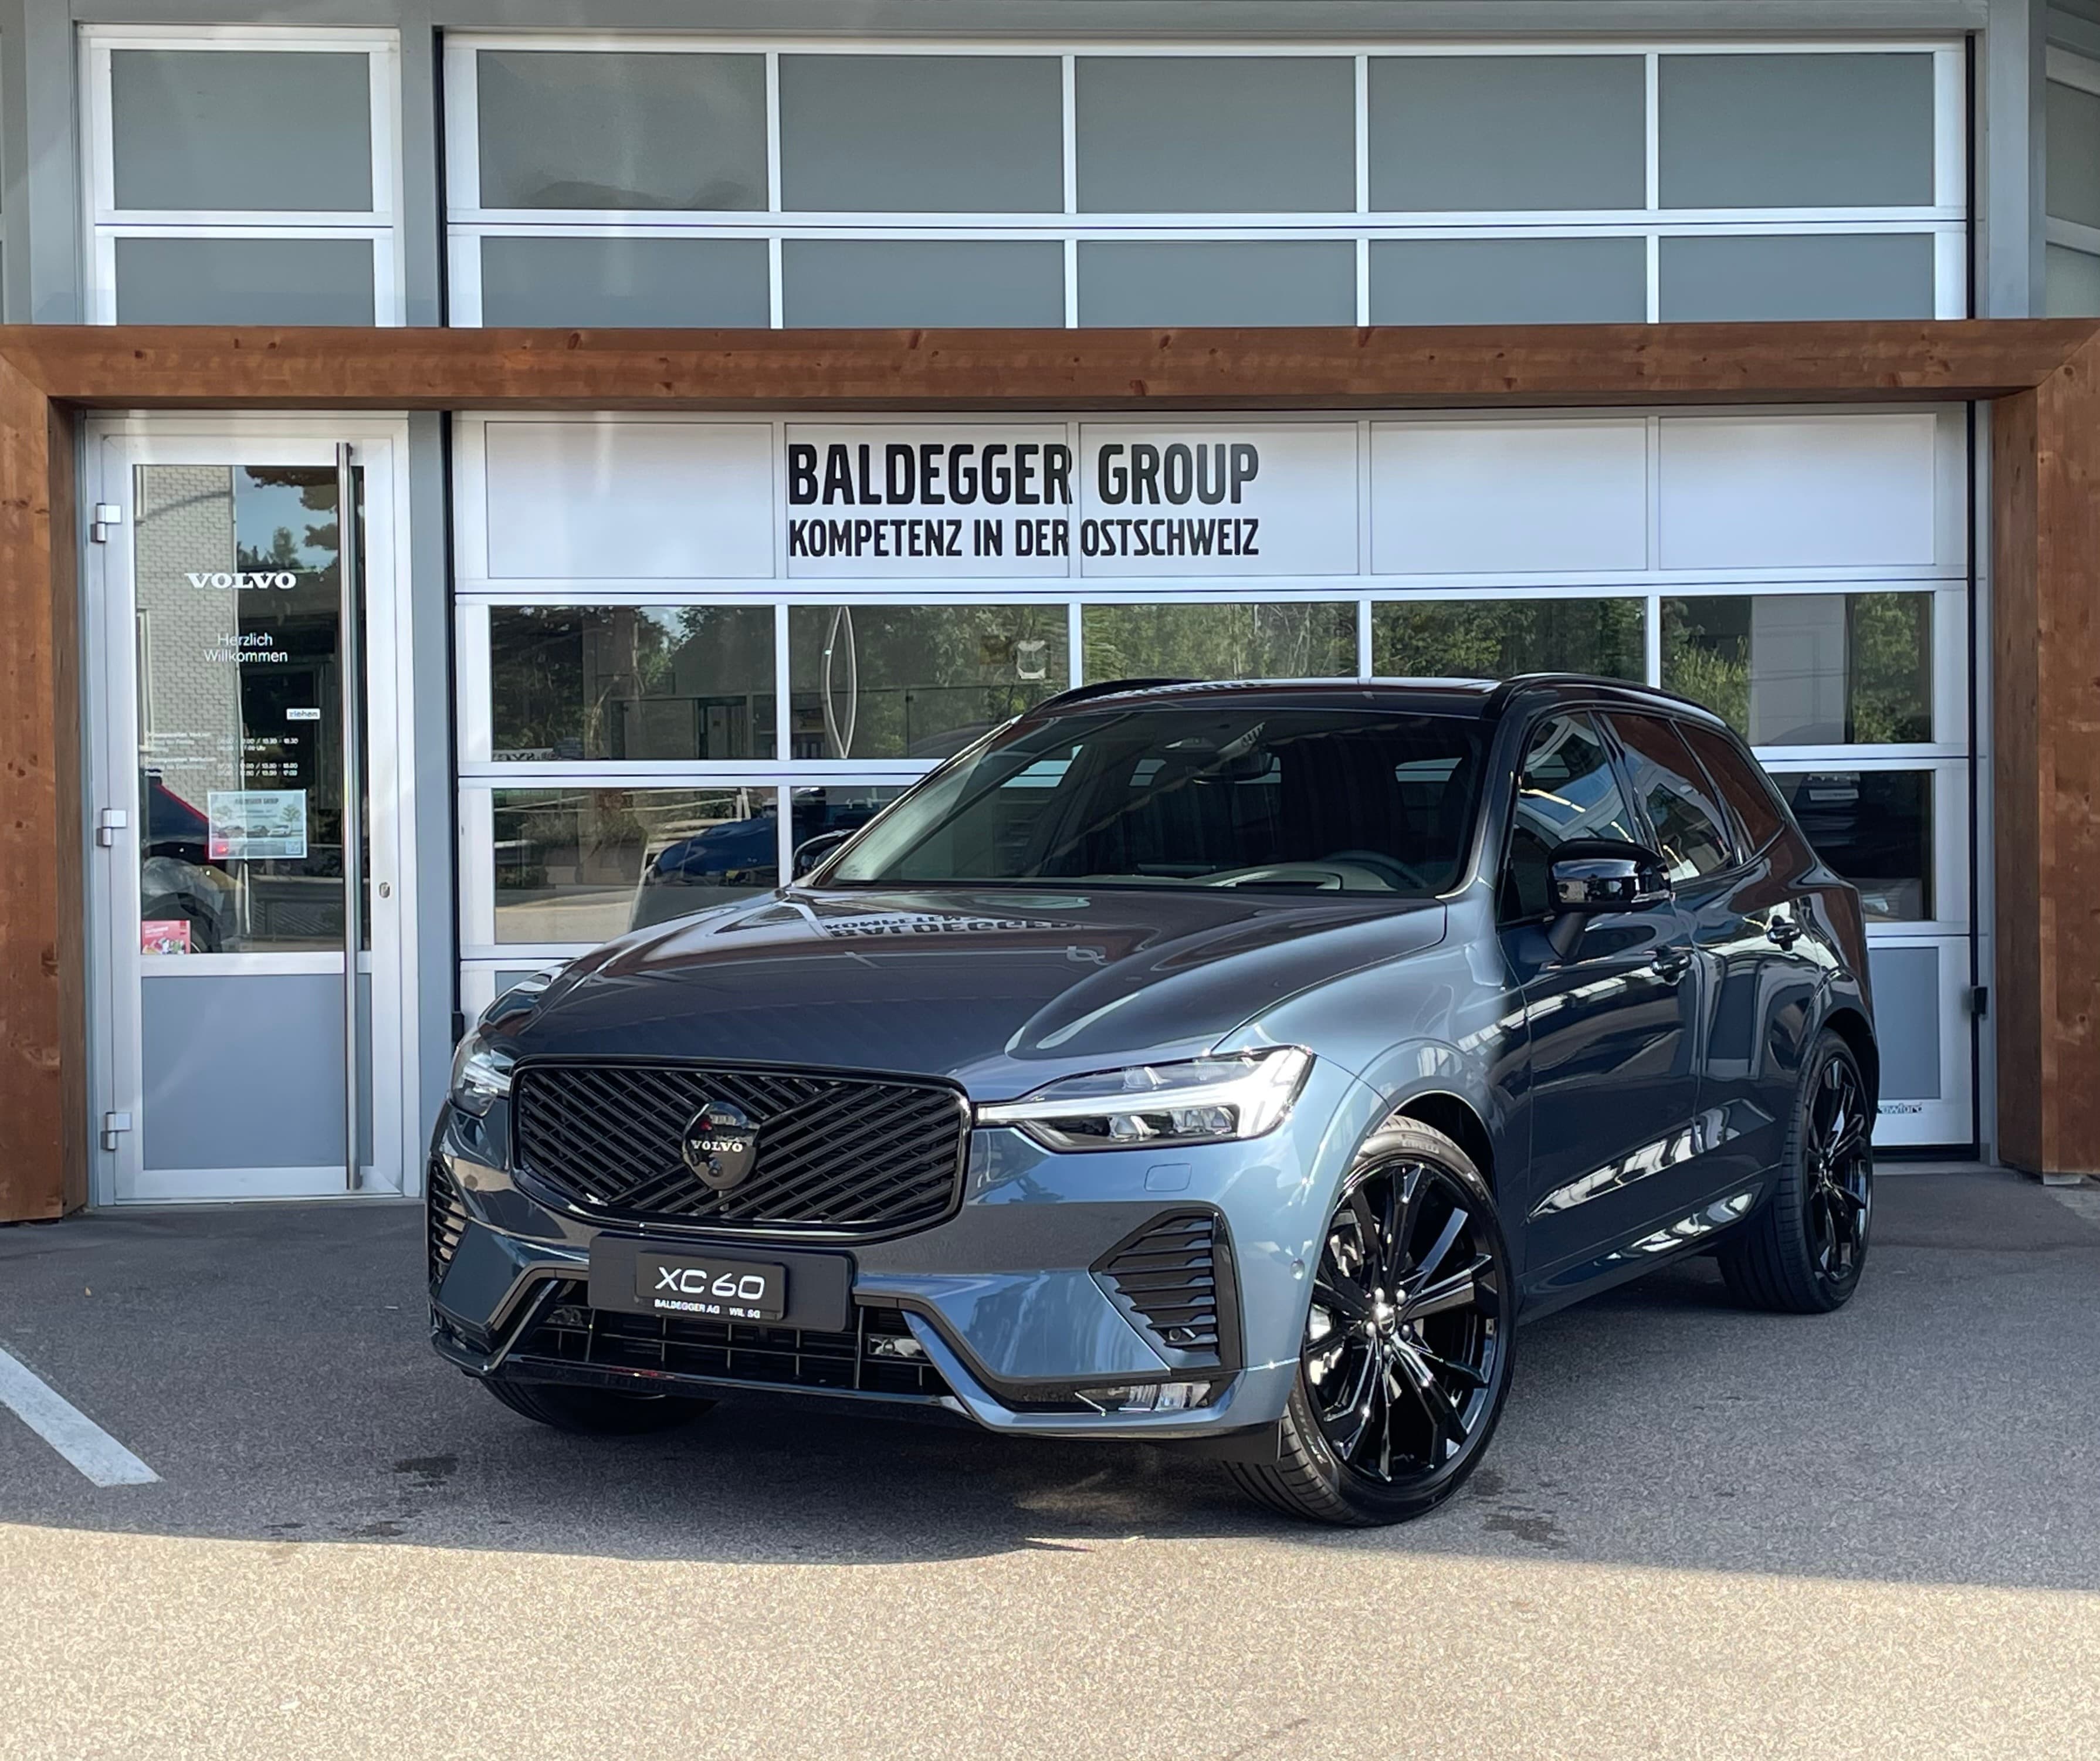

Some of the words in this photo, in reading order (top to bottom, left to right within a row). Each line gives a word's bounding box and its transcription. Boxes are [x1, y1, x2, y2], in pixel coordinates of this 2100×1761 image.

[788, 443, 1072, 505] BALDEGGER
[1098, 443, 1259, 505] GROUP
[789, 519, 962, 557] KOMPETENZ
[974, 519, 1002, 557] IN
[1015, 519, 1069, 557] DER
[1081, 519, 1259, 557] OSTSCHWEIZ
[184, 572, 297, 589] VOLVO
[218, 632, 273, 646] Herzlich
[204, 649, 289, 662] Willkommen
[690, 1139, 744, 1153] VOLVO
[654, 1298, 706, 1313] BALDEGGER
[706, 1304, 720, 1315] AG
[729, 1307, 745, 1318] WIL
[747, 1309, 761, 1319] SG
